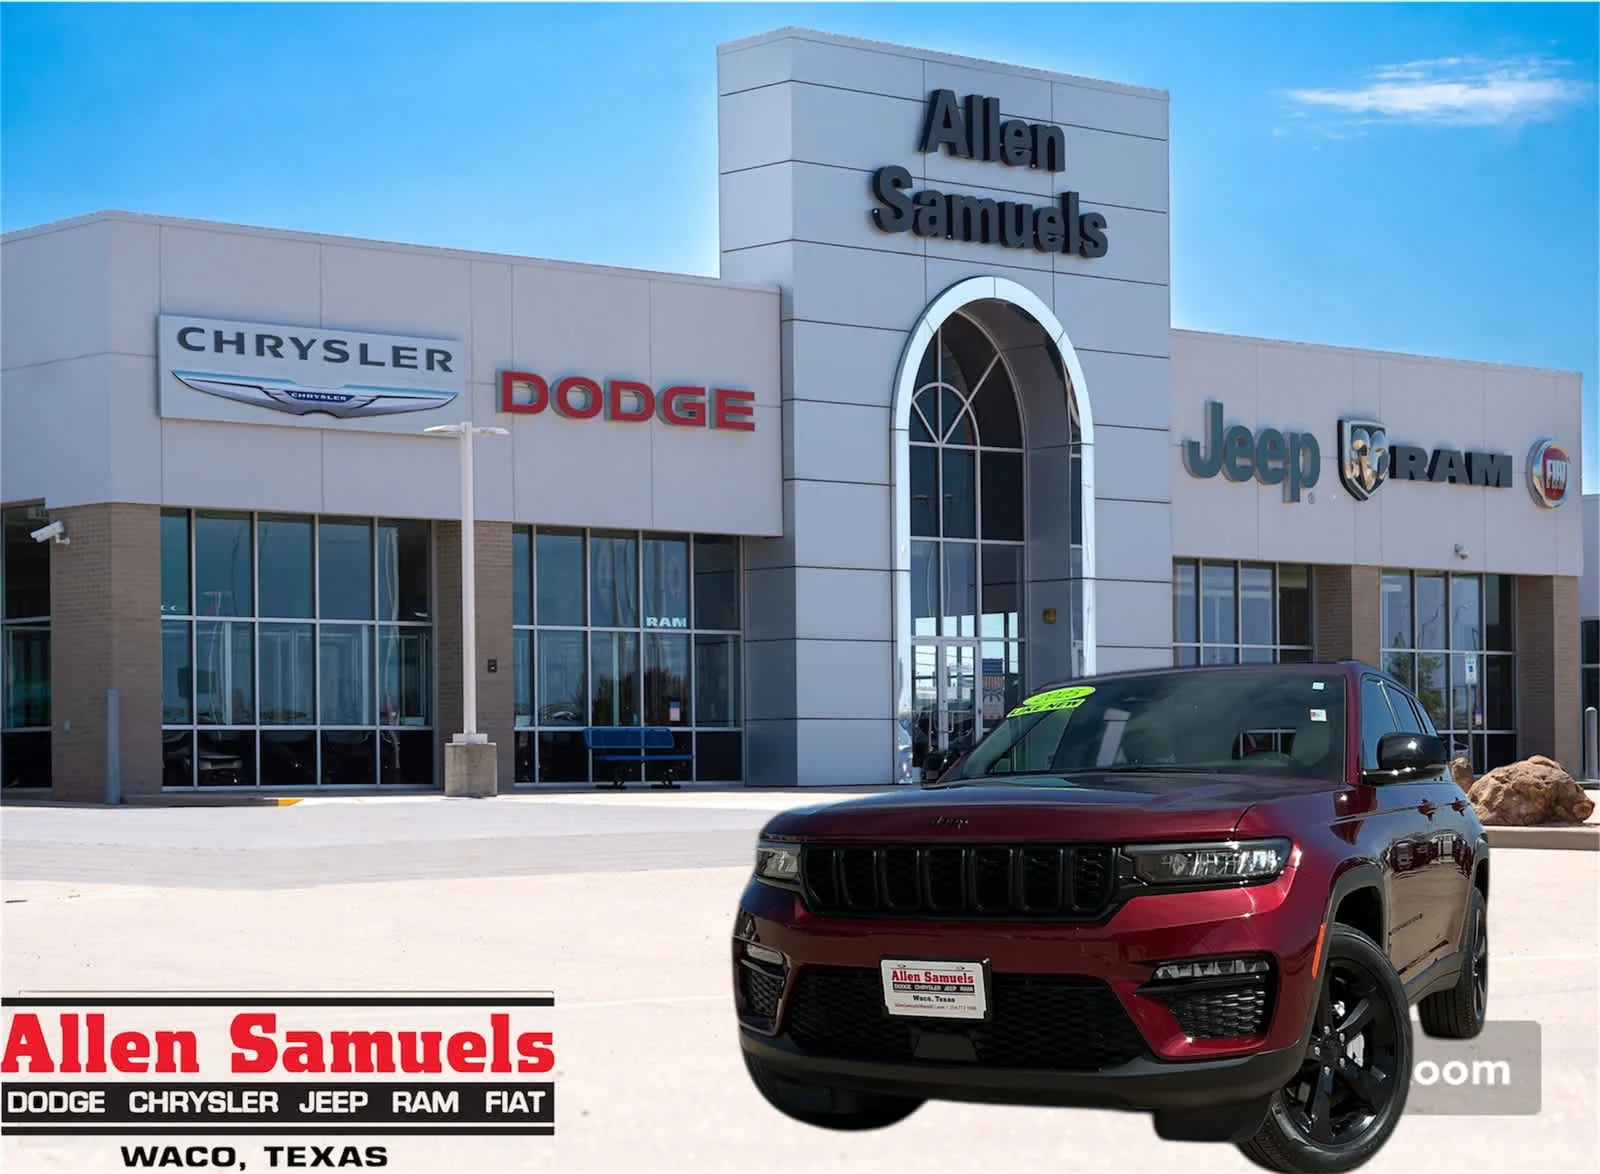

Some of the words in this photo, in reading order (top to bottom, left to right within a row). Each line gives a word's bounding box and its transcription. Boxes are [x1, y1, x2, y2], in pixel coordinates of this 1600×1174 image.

[920, 89, 1066, 172] Allen
[871, 165, 1109, 258] Samuels
[177, 327, 454, 372] CHRYSLER
[291, 391, 347, 401] CHRYSLER
[495, 369, 756, 432] DODGE
[1183, 401, 1321, 503] Jeep
[1388, 445, 1513, 488] RAM
[646, 616, 687, 628] RAM
[892, 970, 921, 982] Allen
[924, 971, 974, 983] Samuels
